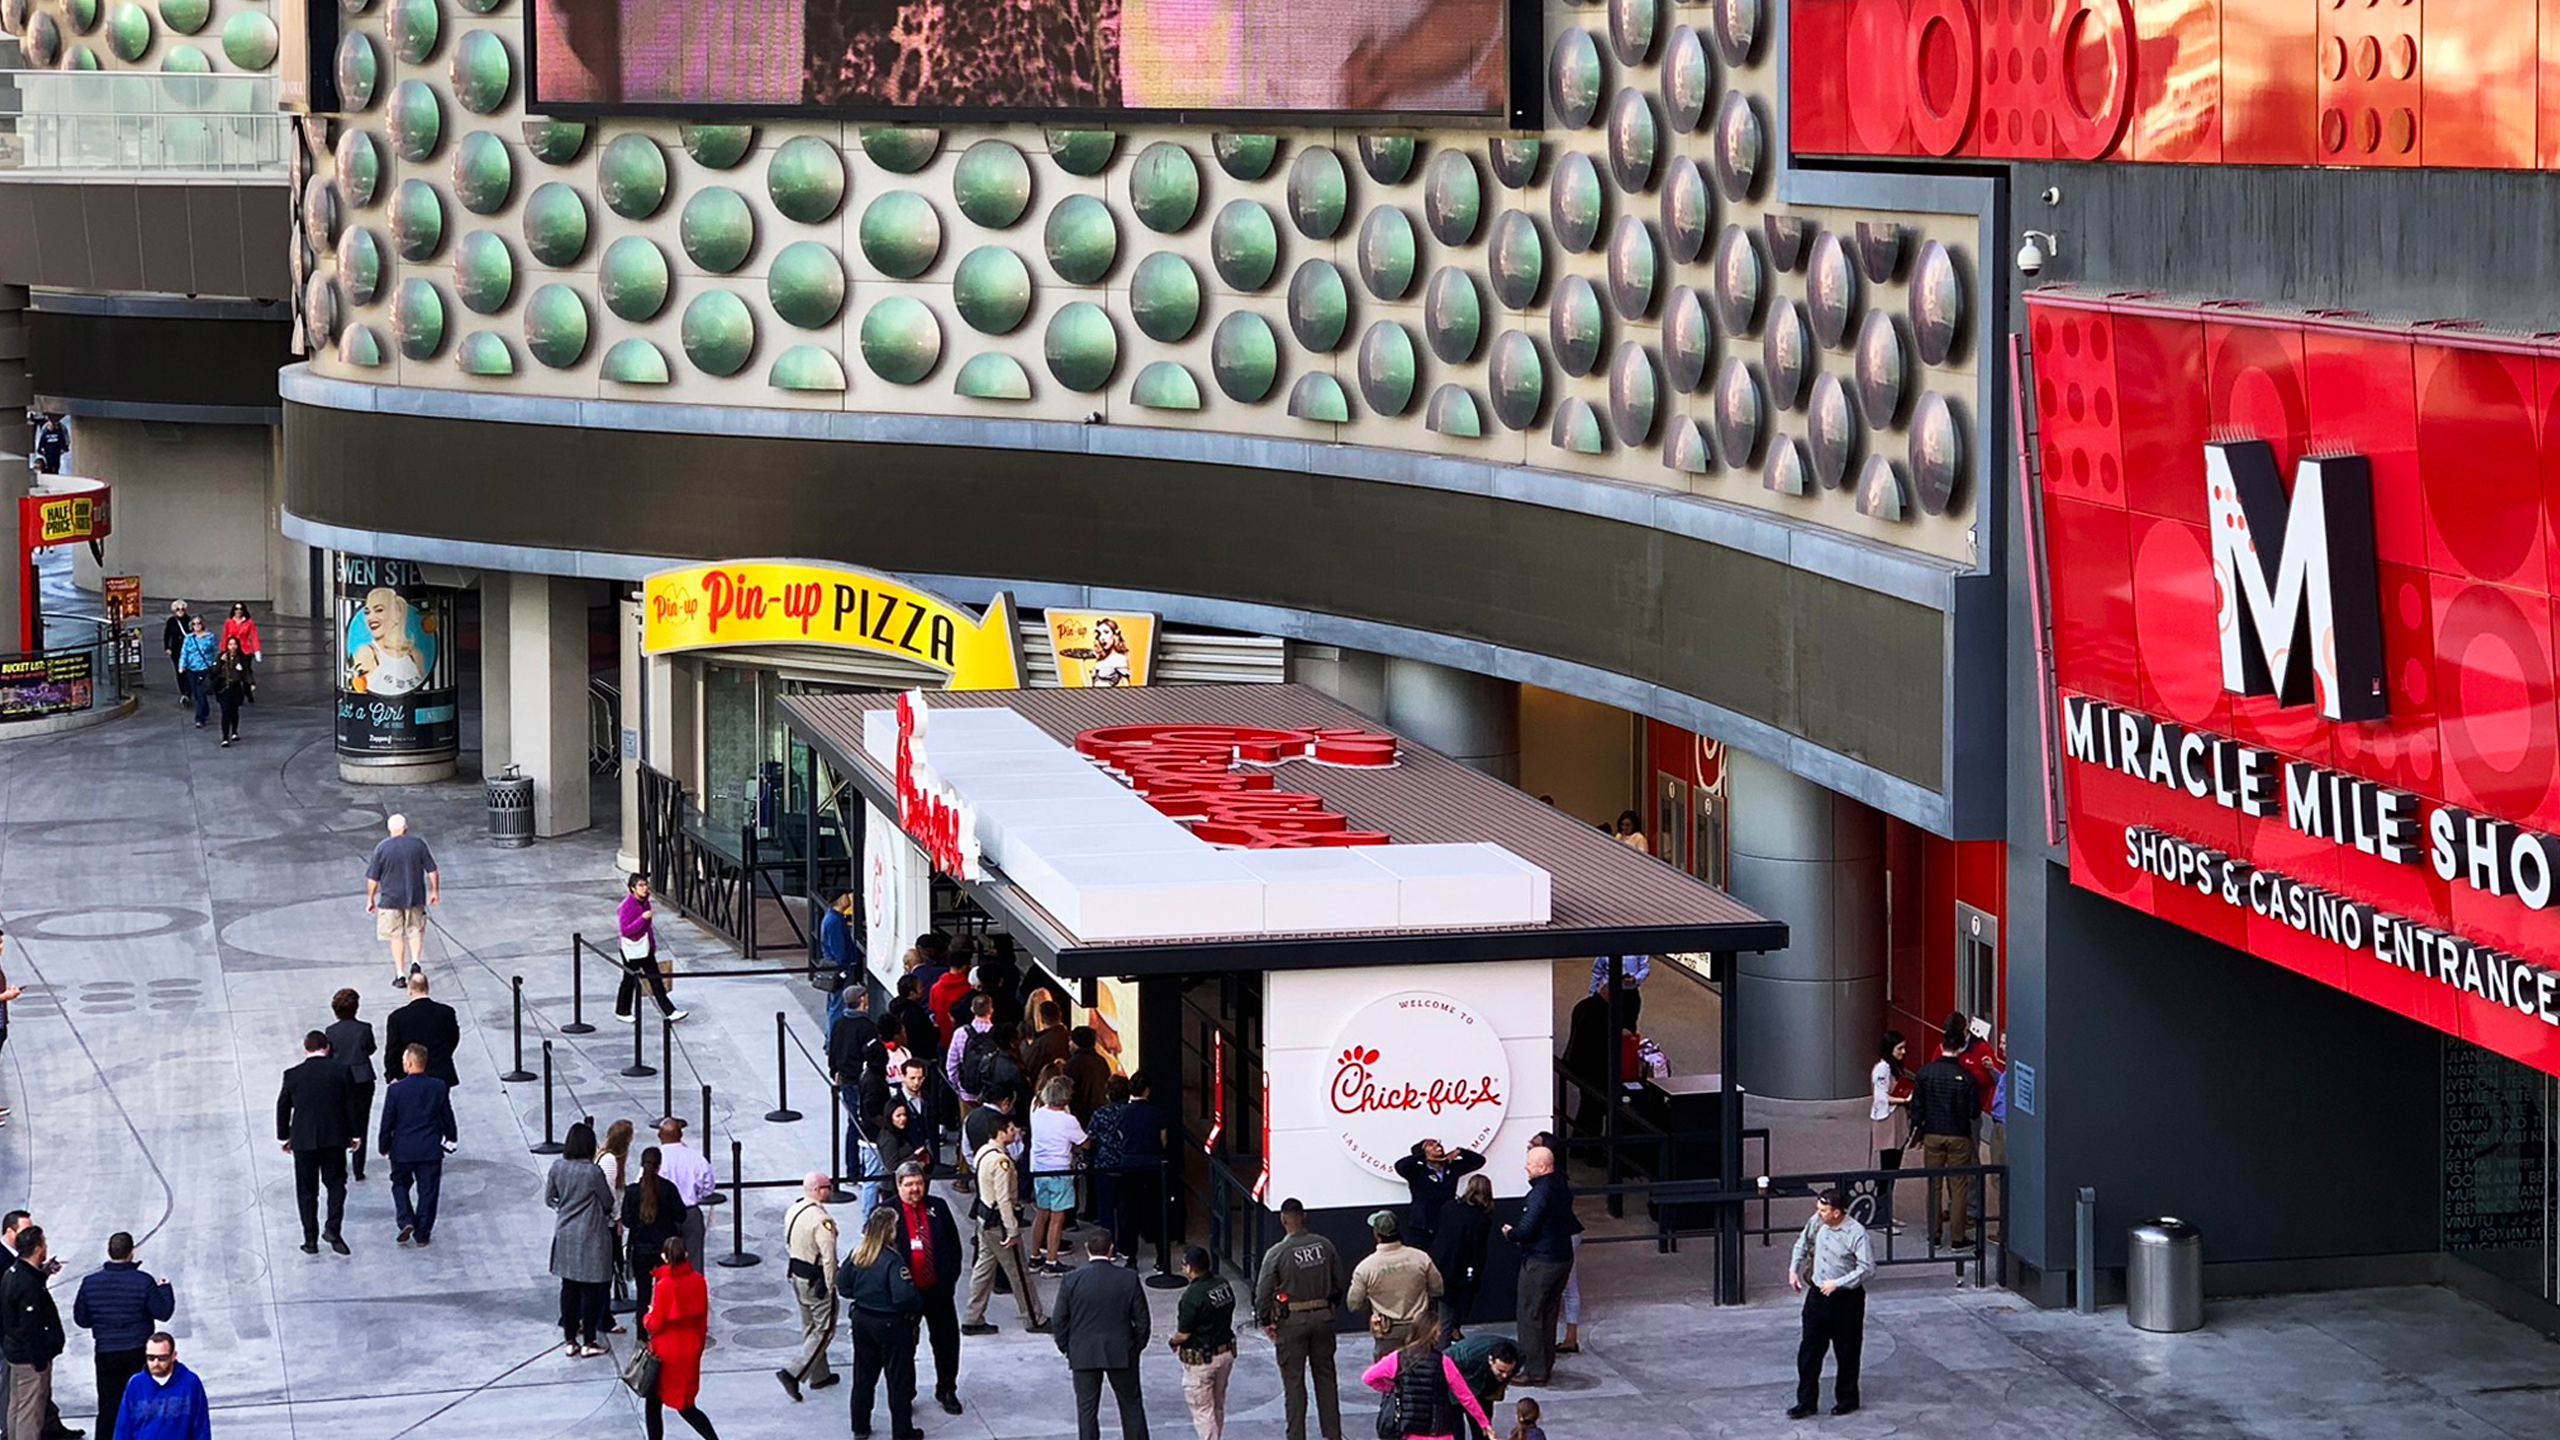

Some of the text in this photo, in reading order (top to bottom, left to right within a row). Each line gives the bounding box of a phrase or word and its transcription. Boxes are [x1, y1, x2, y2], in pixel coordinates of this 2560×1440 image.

[45, 519, 71, 535] PRICE
[46, 506, 69, 520] HALF
[2204, 443, 2342, 721] M
[653, 595, 698, 623] Pin-up
[701, 570, 955, 667] Pin-up PIZZA
[369, 701, 405, 727] Girl
[2063, 695, 2551, 911] MIRACLE MILE SHO
[2125, 826, 2560, 1027] SHOPS & CASINO ENTRANCE
[1398, 999, 1474, 1025] WELCOME TO
[1331, 1061, 1502, 1116] Chick-fil-A
[1341, 1132, 1358, 1152] LAS
[1360, 1151, 1395, 1173] VEGAS
[1294, 1245, 1324, 1265] SRT
[1206, 1284, 1231, 1306] SRT
